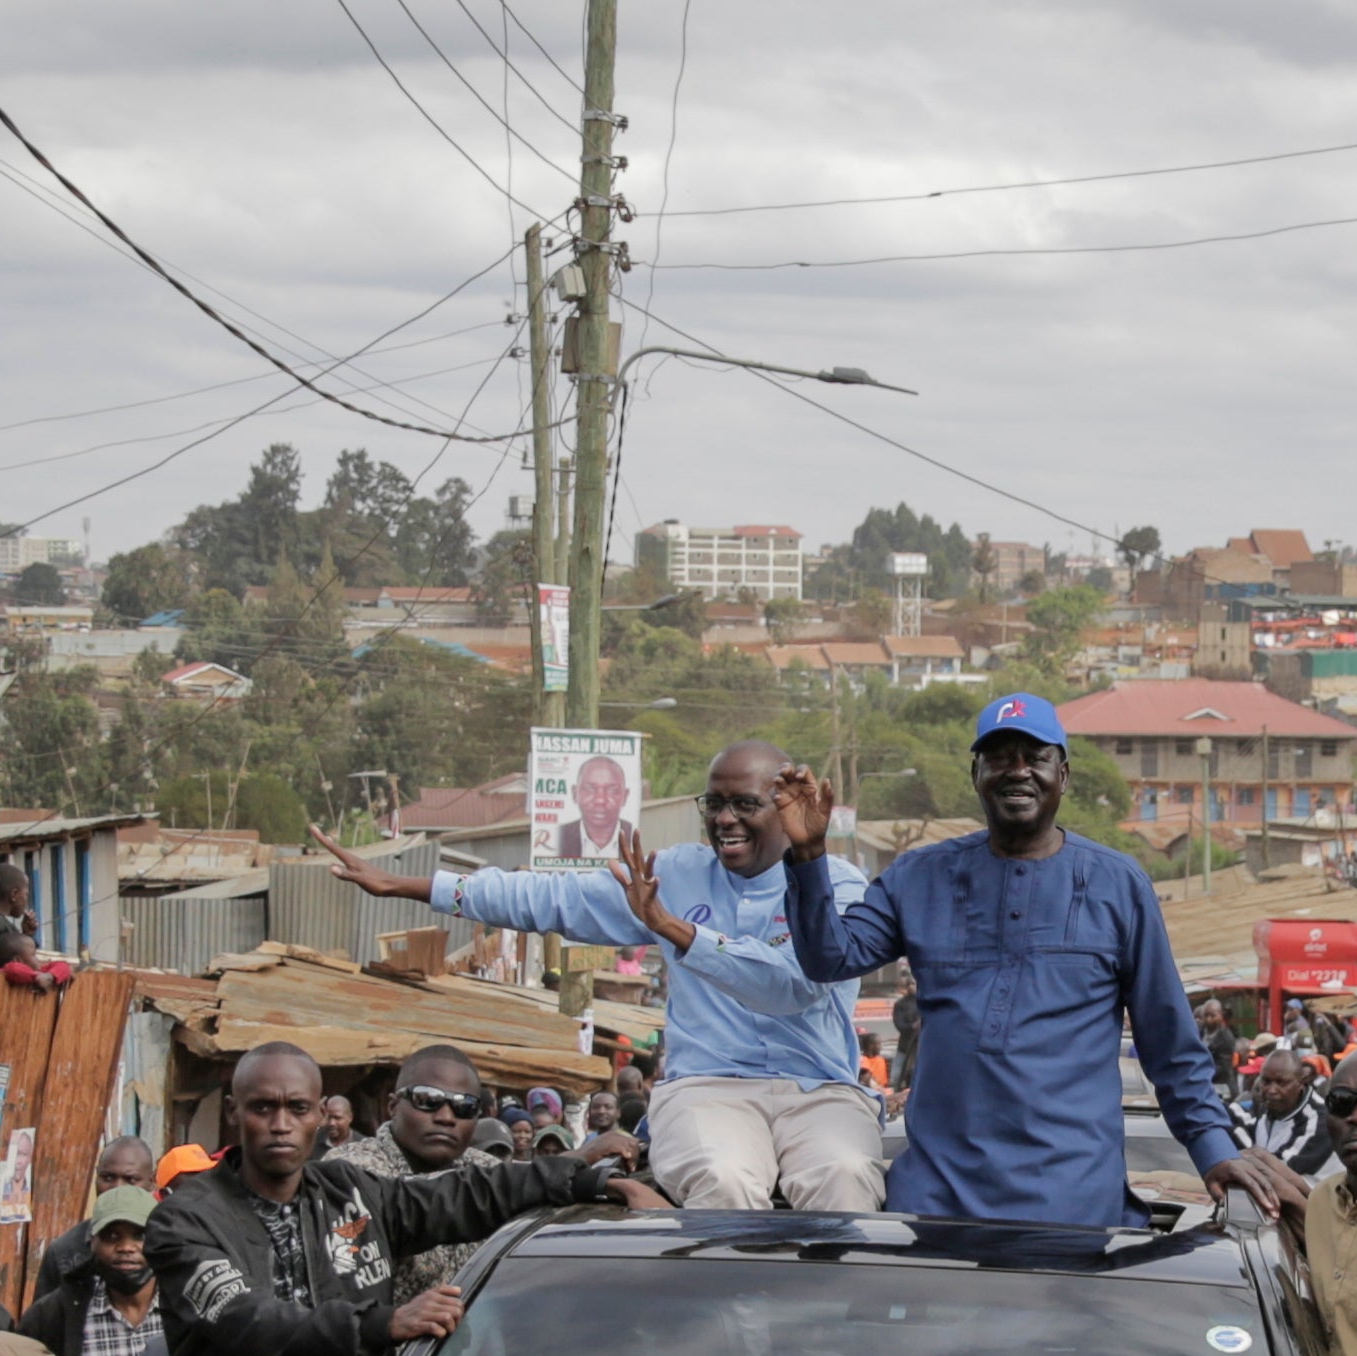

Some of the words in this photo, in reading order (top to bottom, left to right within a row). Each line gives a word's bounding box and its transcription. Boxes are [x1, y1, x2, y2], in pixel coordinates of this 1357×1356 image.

[593, 739, 632, 754] JUMA
[535, 857, 575, 867] UMOJA
[576, 858, 592, 867] NA
[1287, 969, 1309, 981] Dial
